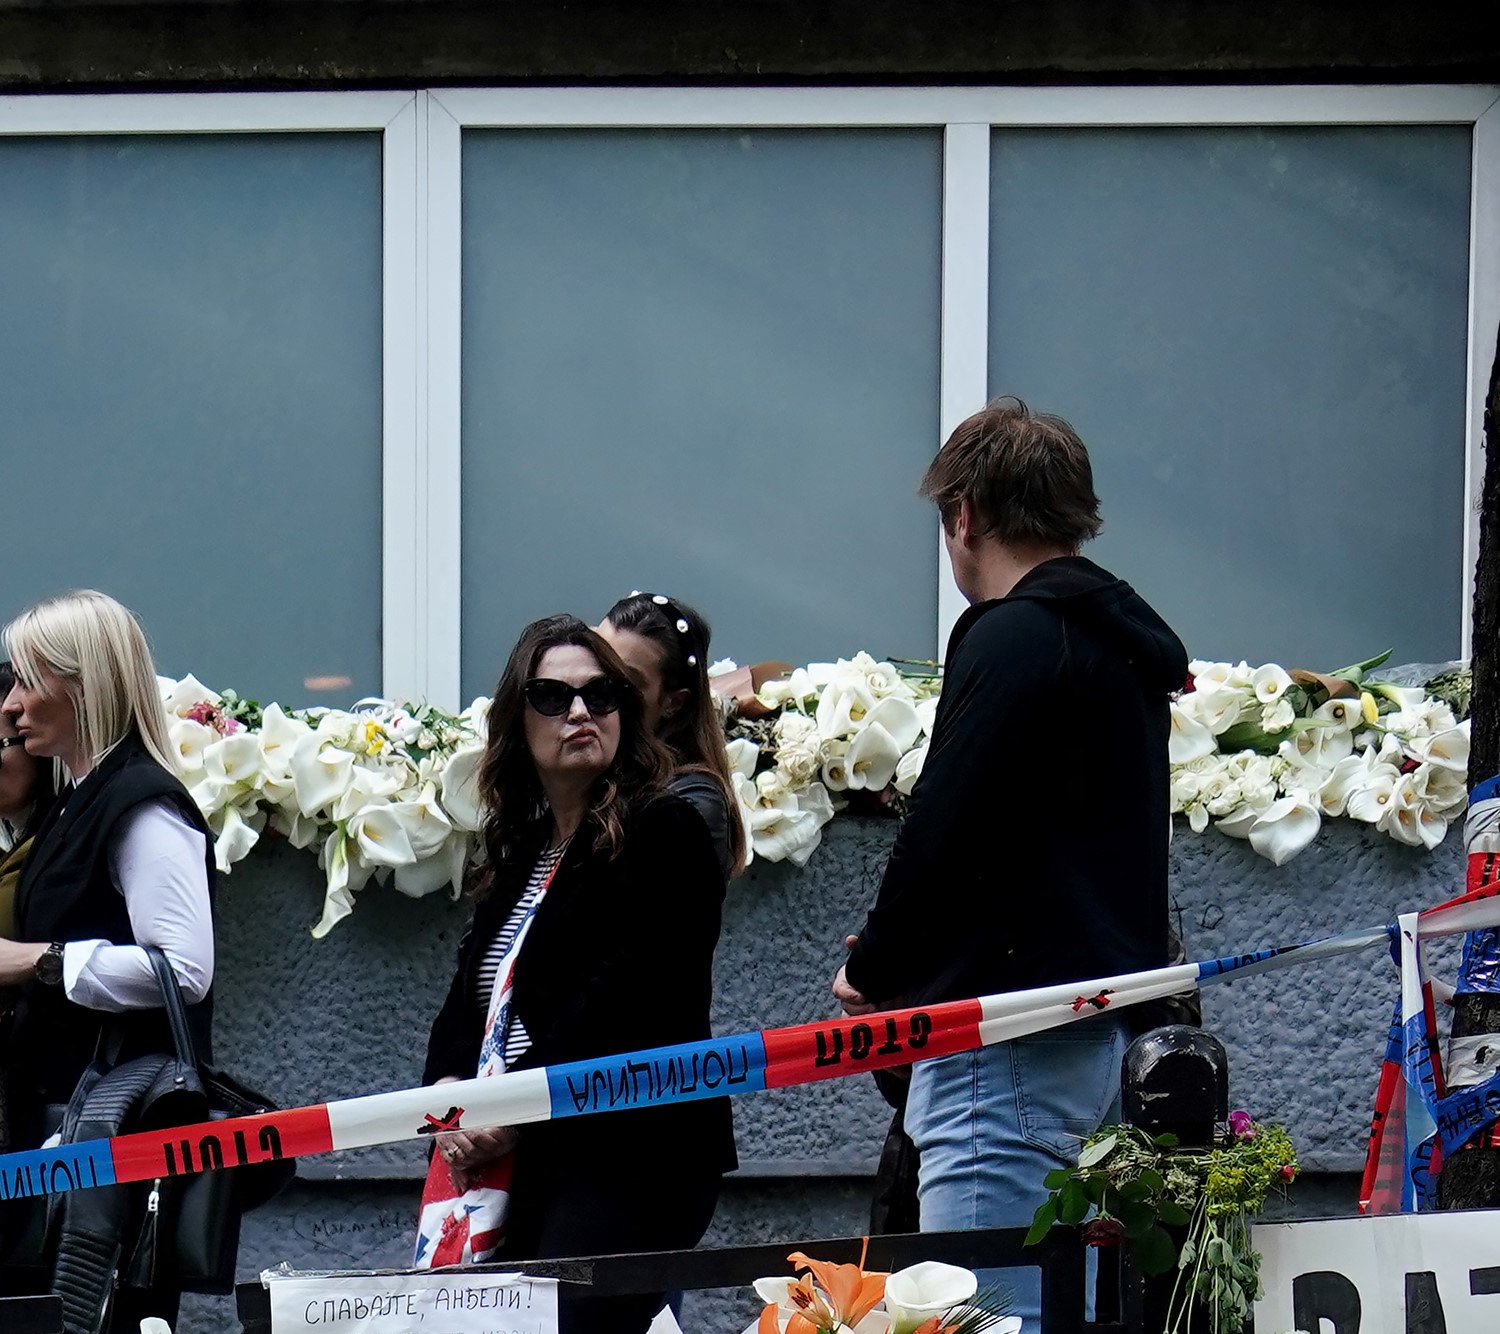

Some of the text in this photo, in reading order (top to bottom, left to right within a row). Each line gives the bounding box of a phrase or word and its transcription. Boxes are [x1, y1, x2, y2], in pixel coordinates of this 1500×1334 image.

[567, 1012, 932, 1114] ПОЛИЦИЈА СТОП
[434, 1282, 533, 1311] АНЂЕЛИ!
